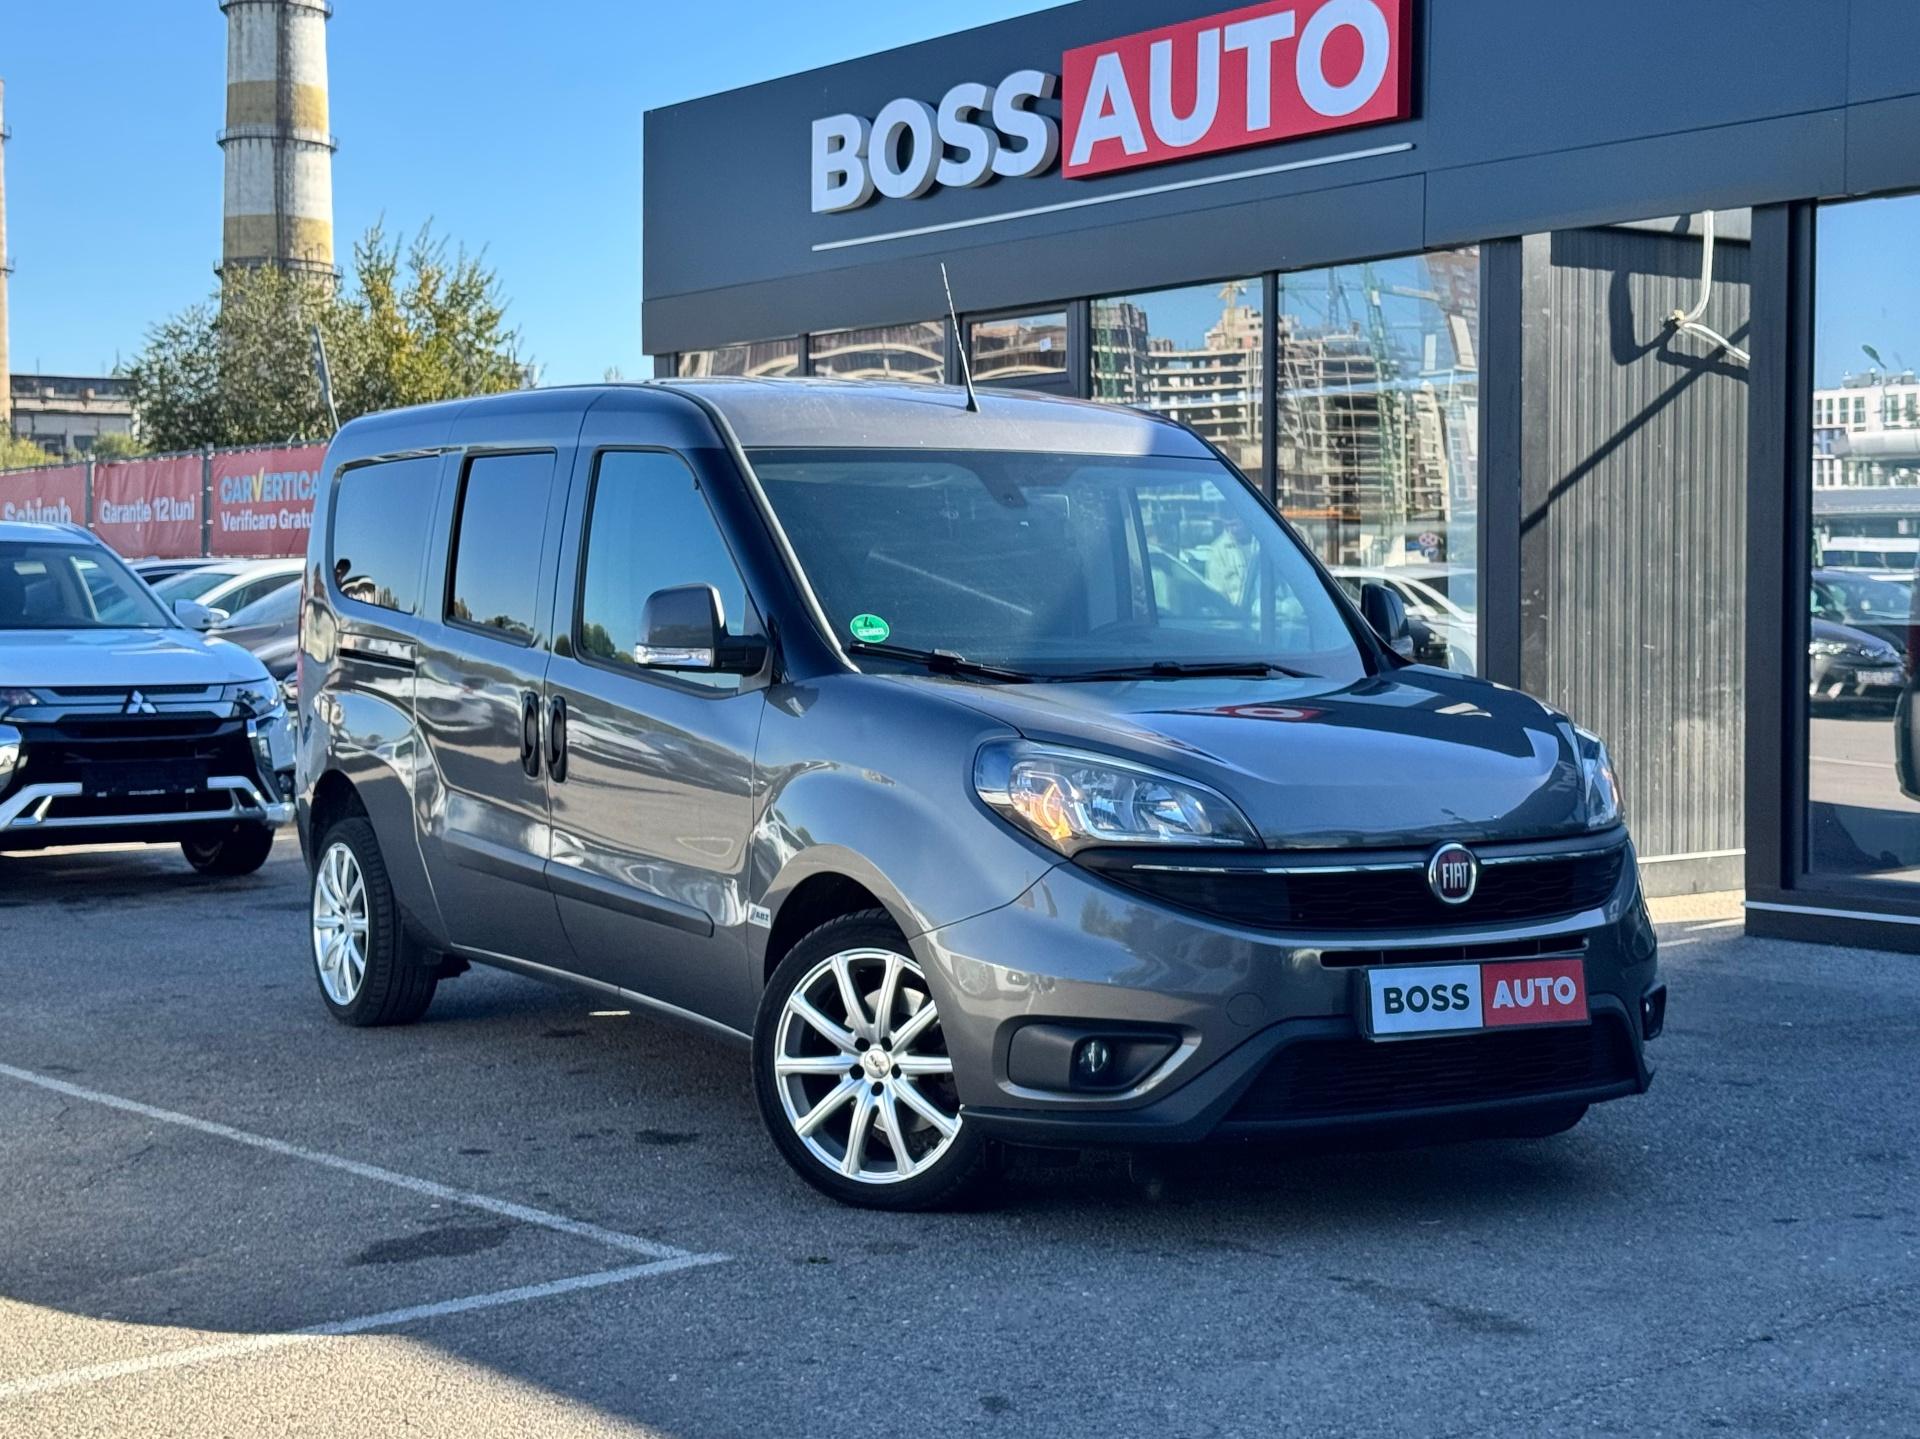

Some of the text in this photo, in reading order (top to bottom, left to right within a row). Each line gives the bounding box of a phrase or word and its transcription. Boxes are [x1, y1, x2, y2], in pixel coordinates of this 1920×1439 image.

[811, 0, 1391, 212] BOSS AUTO
[153, 496, 169, 521] 12
[170, 494, 194, 521] luni
[221, 508, 277, 531] Verificare
[1442, 862, 1468, 889] FIAT
[1384, 976, 1577, 1015] BOSS AUTO
